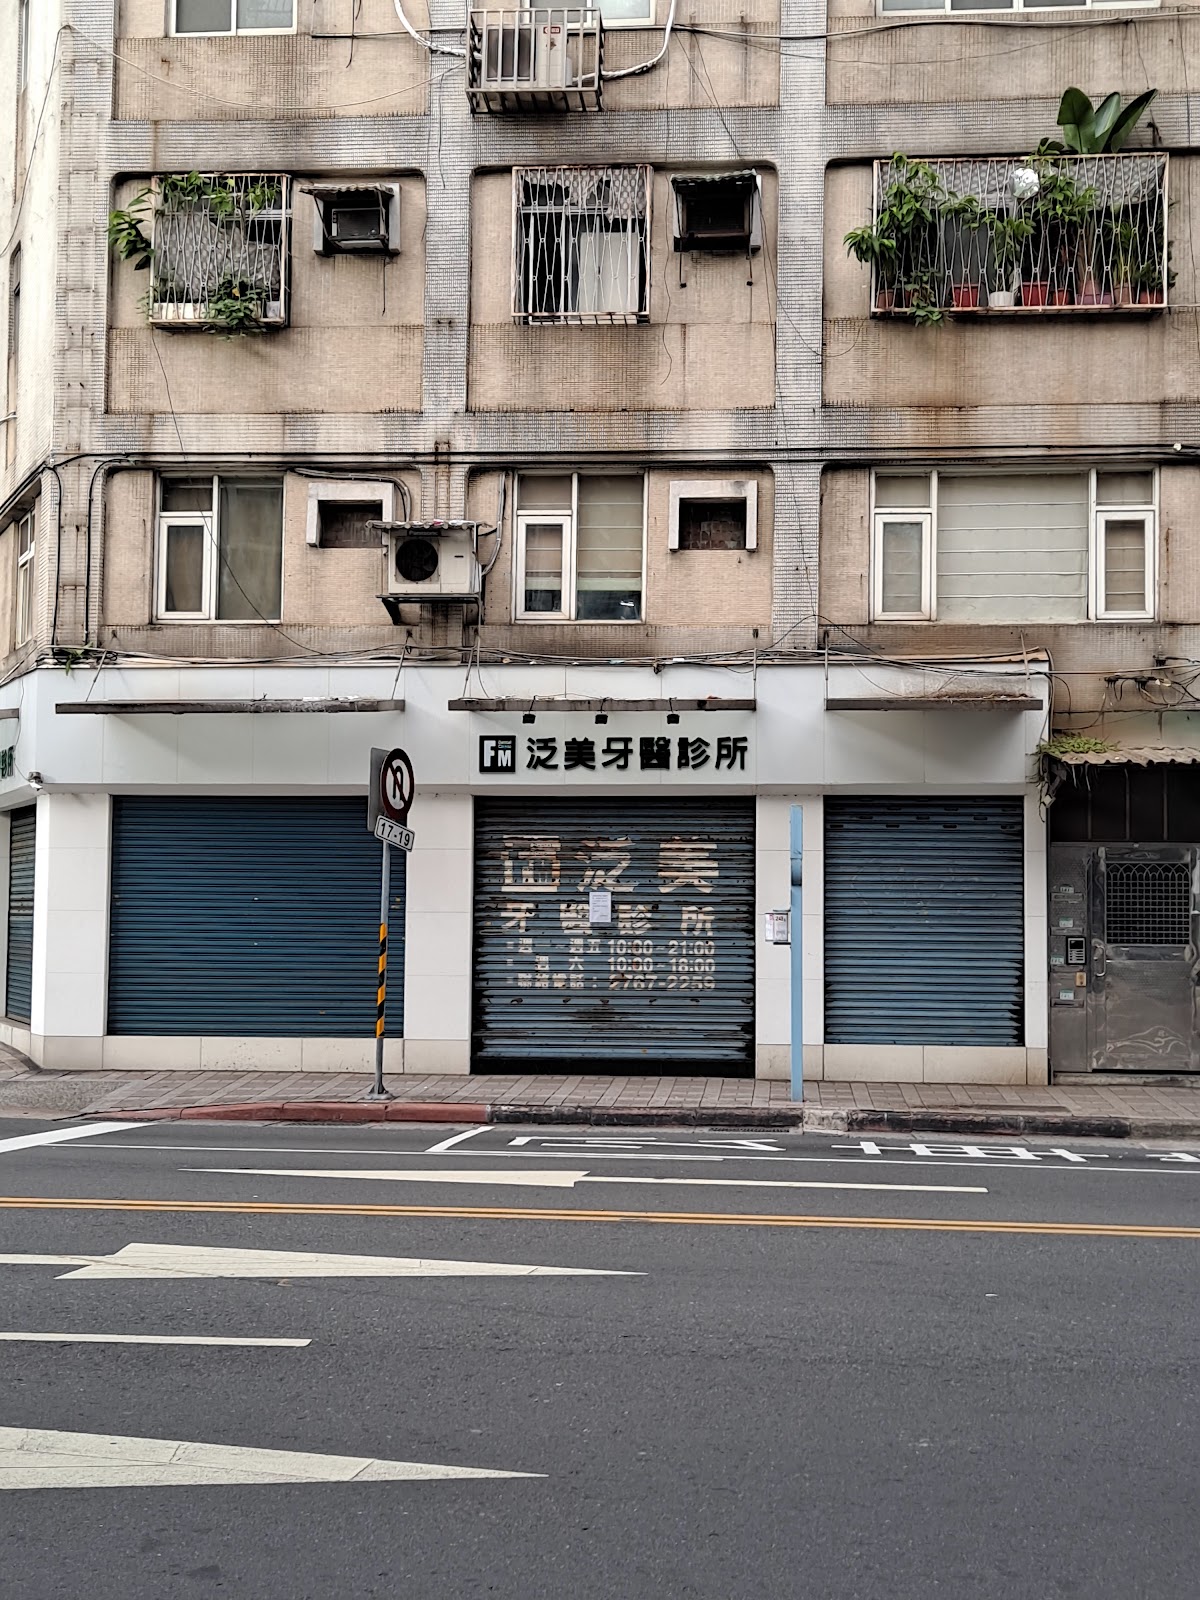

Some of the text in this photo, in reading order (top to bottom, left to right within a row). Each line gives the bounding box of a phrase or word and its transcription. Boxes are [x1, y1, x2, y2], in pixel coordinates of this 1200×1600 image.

[526, 737, 748, 770] 泛美牙醫診所
